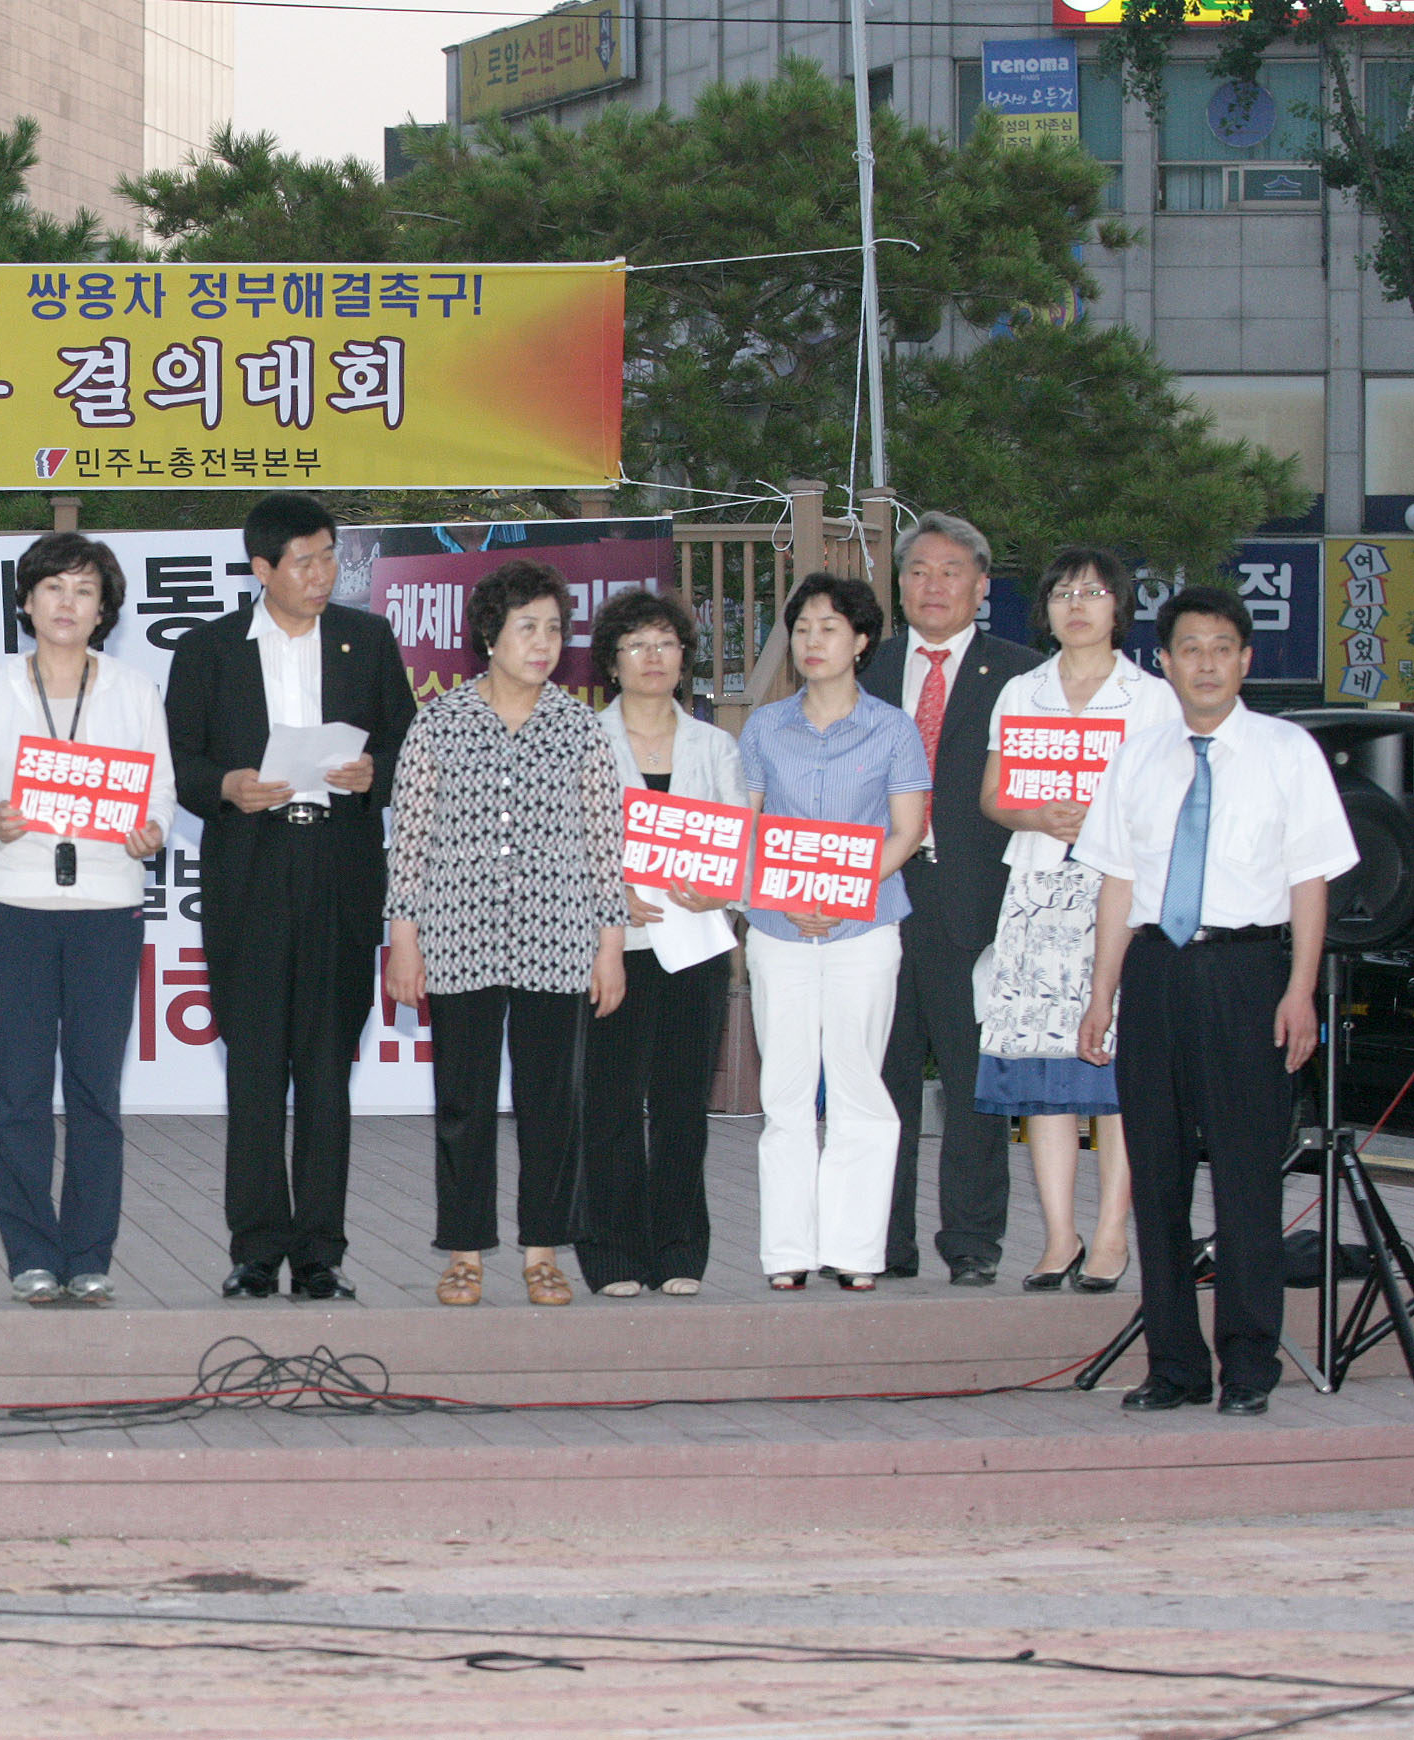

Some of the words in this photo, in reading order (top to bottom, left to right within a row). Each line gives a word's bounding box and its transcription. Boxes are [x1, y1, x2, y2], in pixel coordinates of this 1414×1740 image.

[991, 57, 1069, 74] renoma
[1000, 119, 1029, 134] 성의
[1035, 118, 1072, 131] 자존심
[26, 273, 166, 320] 쌍용차
[188, 272, 483, 319] 정부해결촉구!
[54, 336, 406, 430] 결의대회
[75, 446, 322, 480] 민주노총전북본부
[386, 583, 463, 649] 해체!
[1354, 548, 1373, 694] 여기있었네
[1003, 728, 1081, 761] 조중동방송
[17, 747, 106, 788] 조중동방송
[106, 760, 150, 793] 반대!
[1005, 769, 1074, 801] 재벌방송
[19, 788, 93, 828] 재벌방송
[94, 798, 139, 833] 반대!
[627, 800, 744, 849] 언론악법
[622, 839, 738, 887] 폐기하라!
[765, 828, 877, 869] 언론악법
[759, 866, 872, 908] 폐기하라!
